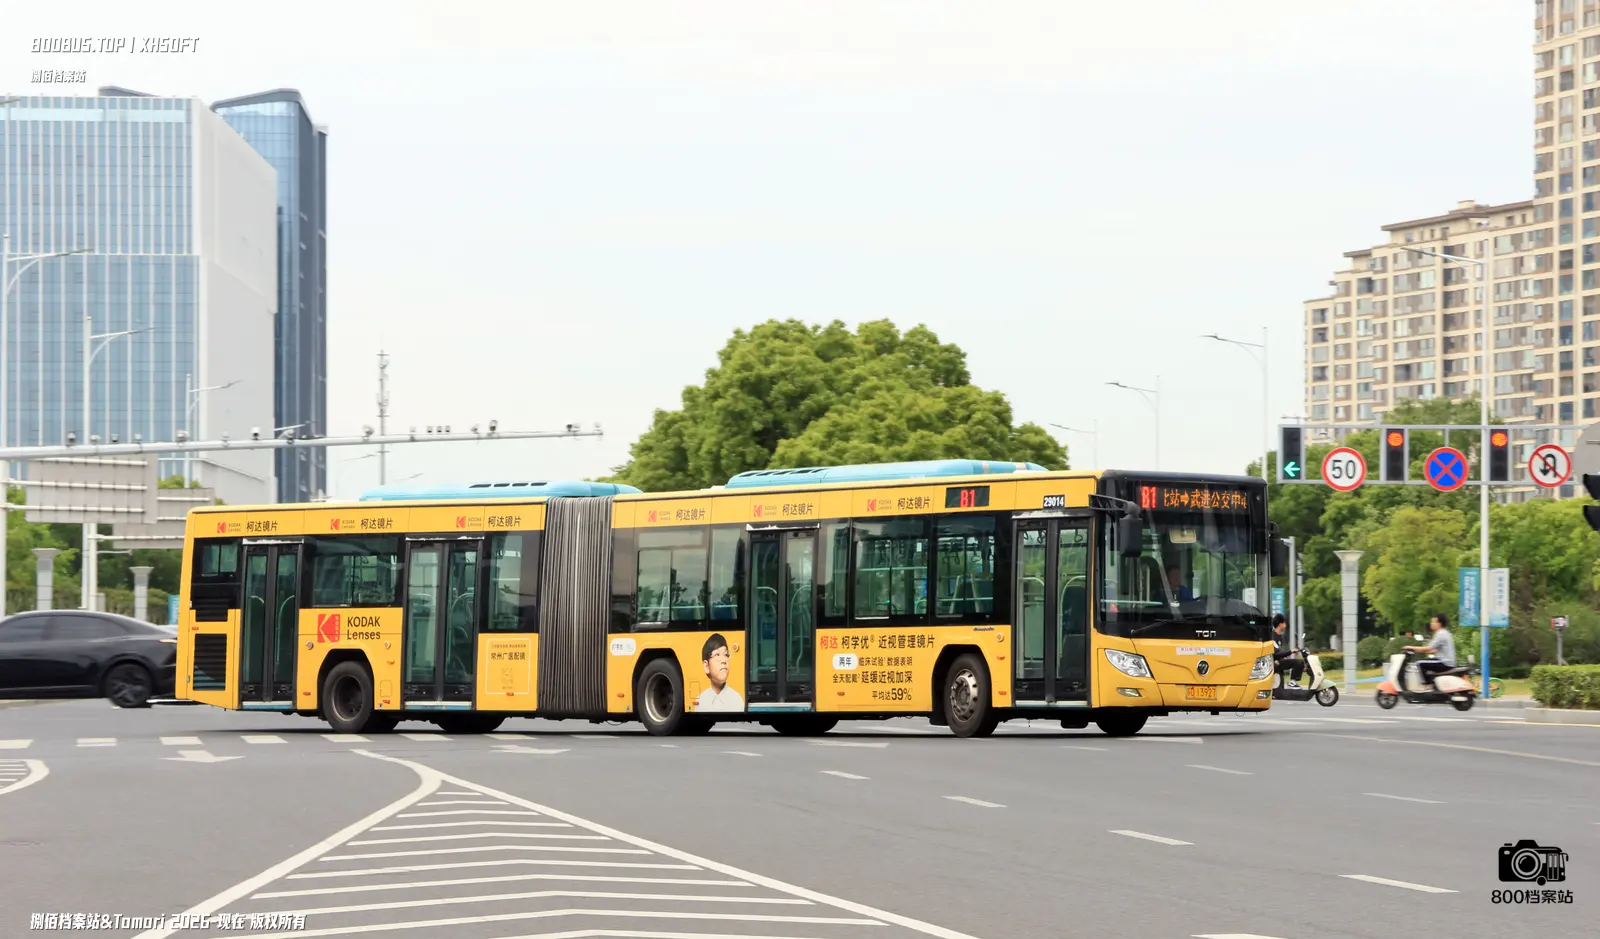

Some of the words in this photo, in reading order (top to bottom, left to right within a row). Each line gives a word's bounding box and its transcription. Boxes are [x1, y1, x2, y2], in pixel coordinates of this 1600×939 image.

[1332, 459, 1356, 479] 50
[897, 496, 931, 510] 柯达镜片
[960, 489, 976, 508] B1
[1141, 485, 1157, 509] B1
[675, 508, 706, 521] 柯达镜片
[782, 502, 814, 517] 柯达镜片
[246, 520, 279, 533] 柯达镜片
[360, 517, 393, 530] 柯达镜片
[487, 515, 522, 528] 柯达镜片
[347, 616, 381, 627] KODAK
[347, 629, 381, 640] Lenses
[819, 635, 838, 650] 柯达
[878, 634, 935, 649] 近视管理镜片
[838, 656, 852, 667] 两年
[871, 687, 912, 701] 平均达59%
